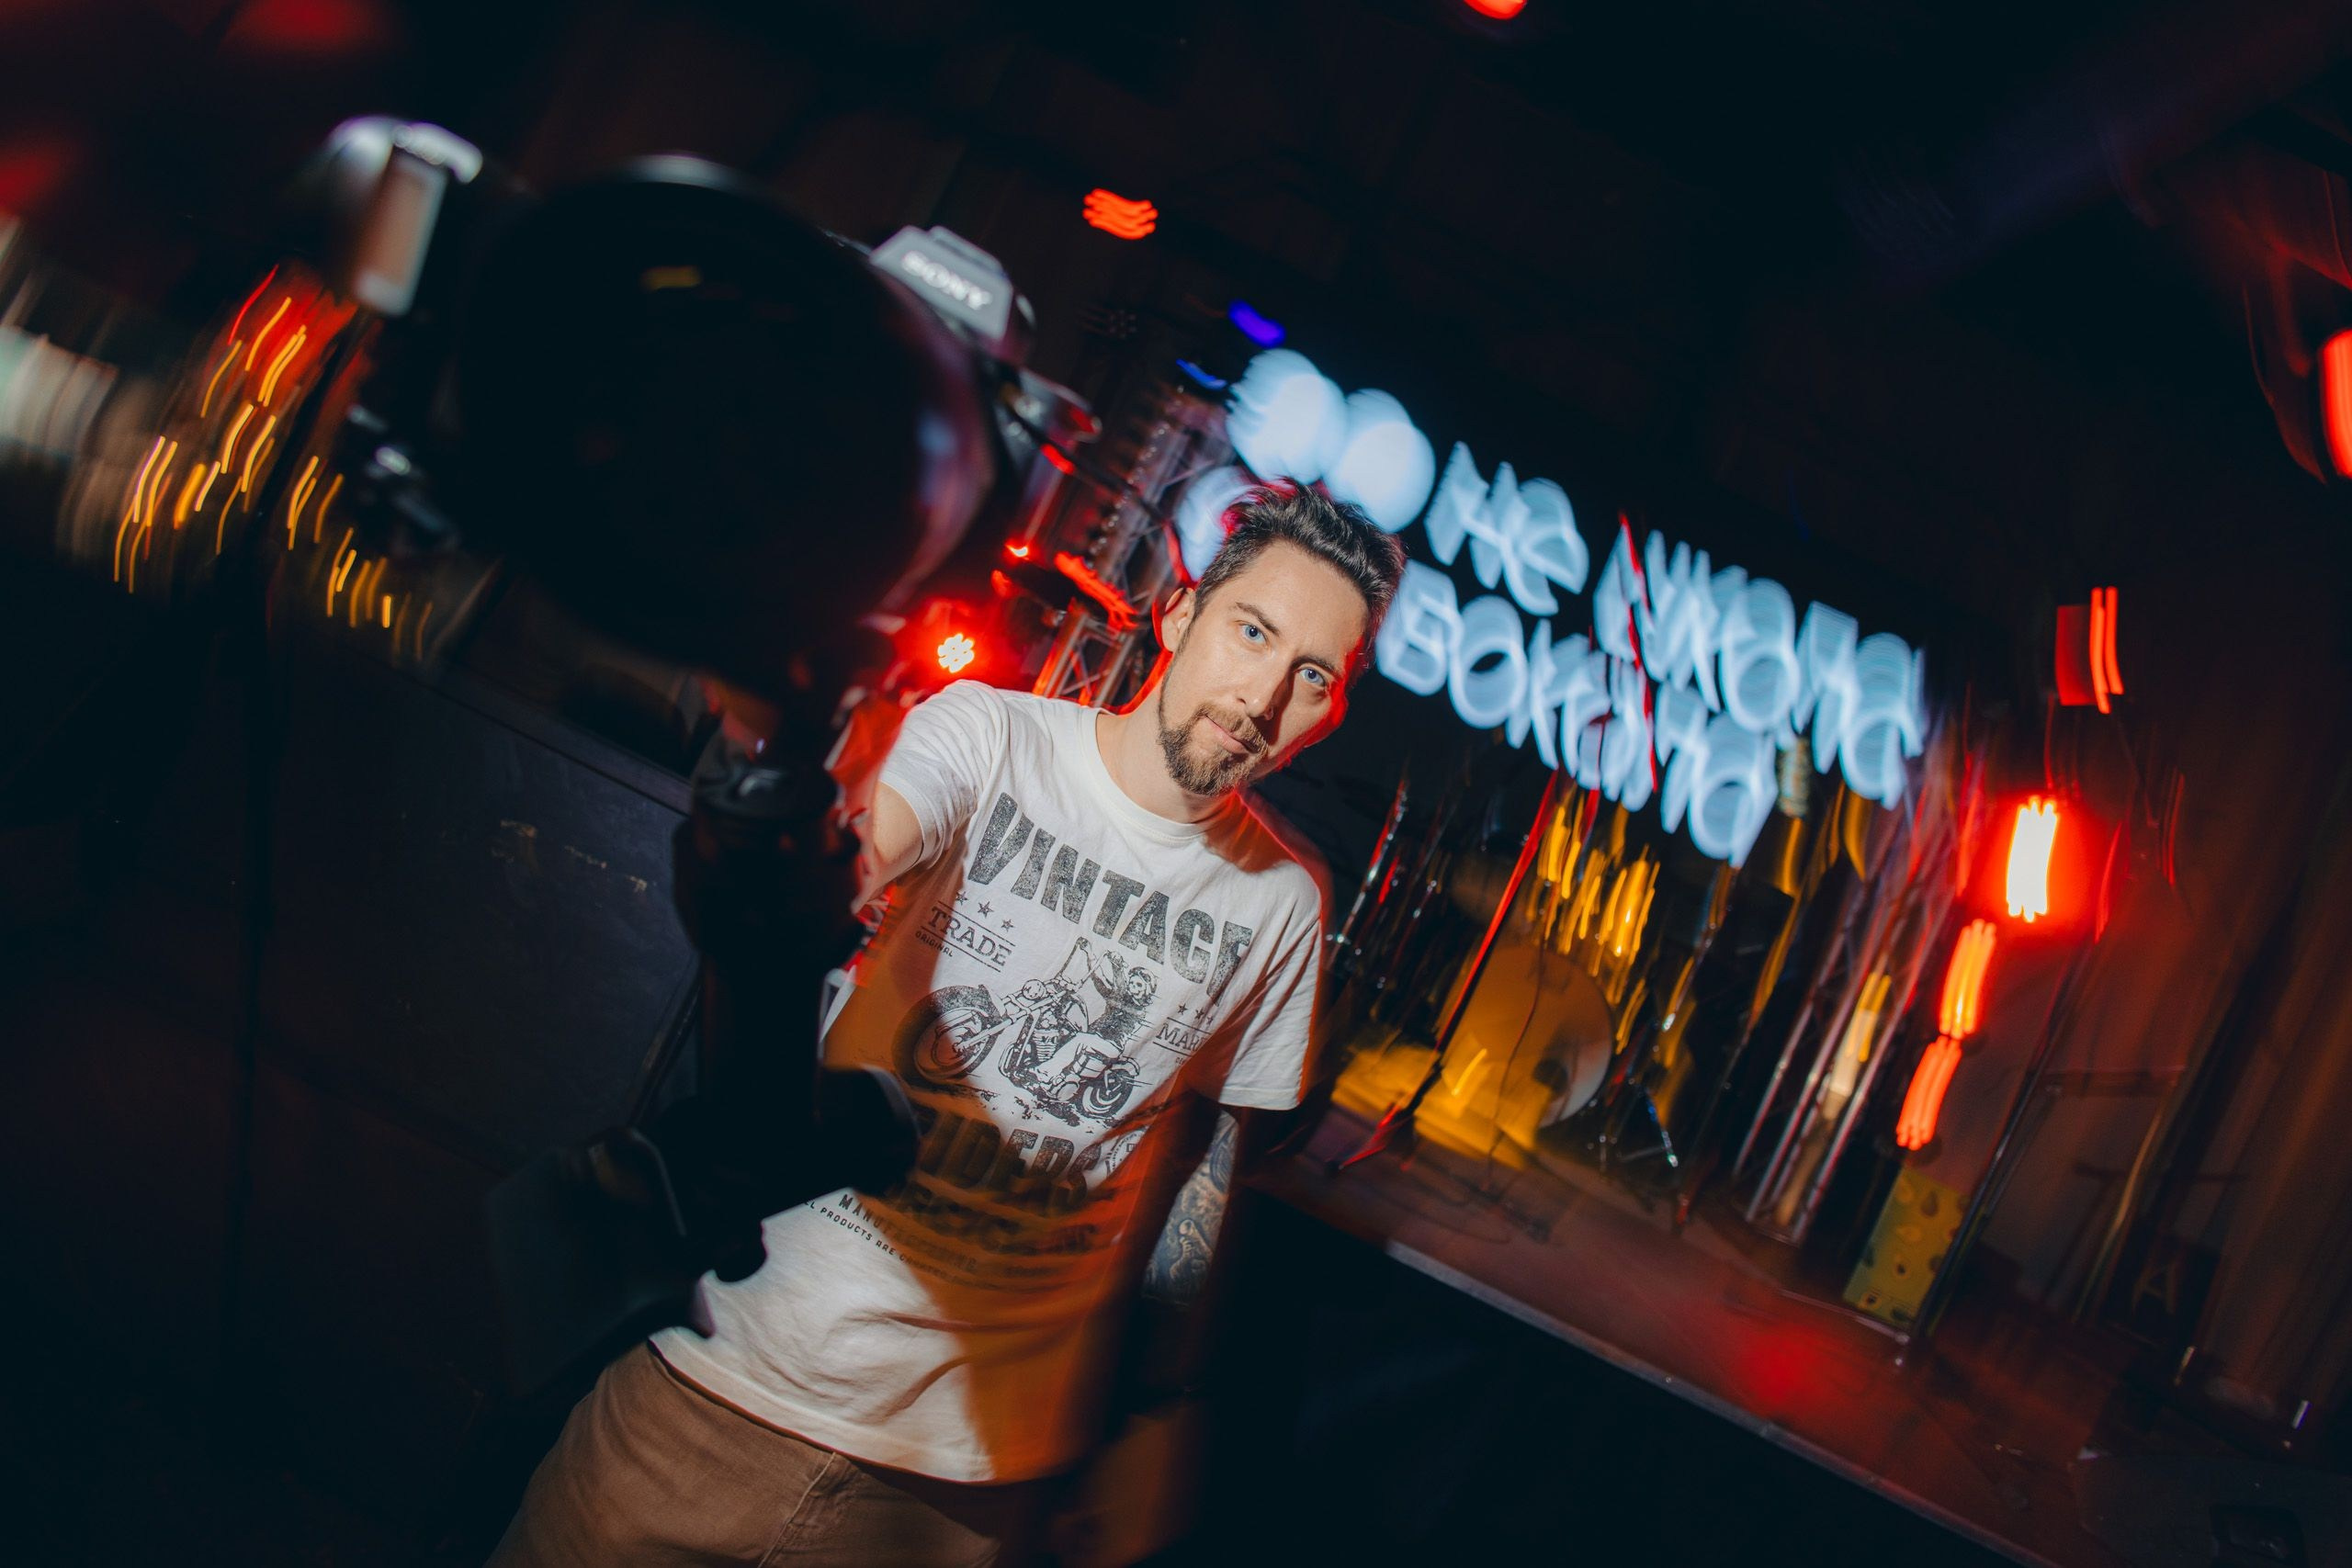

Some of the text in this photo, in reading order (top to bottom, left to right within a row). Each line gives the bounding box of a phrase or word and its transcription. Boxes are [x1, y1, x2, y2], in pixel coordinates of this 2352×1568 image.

[915, 930, 953, 957] ORIGINAL
[928, 906, 1012, 966] TRADE
[913, 1102, 1102, 1212] IDERS
[820, 1207, 873, 1241] PRODUCTS
[876, 1240, 896, 1256] ARE
